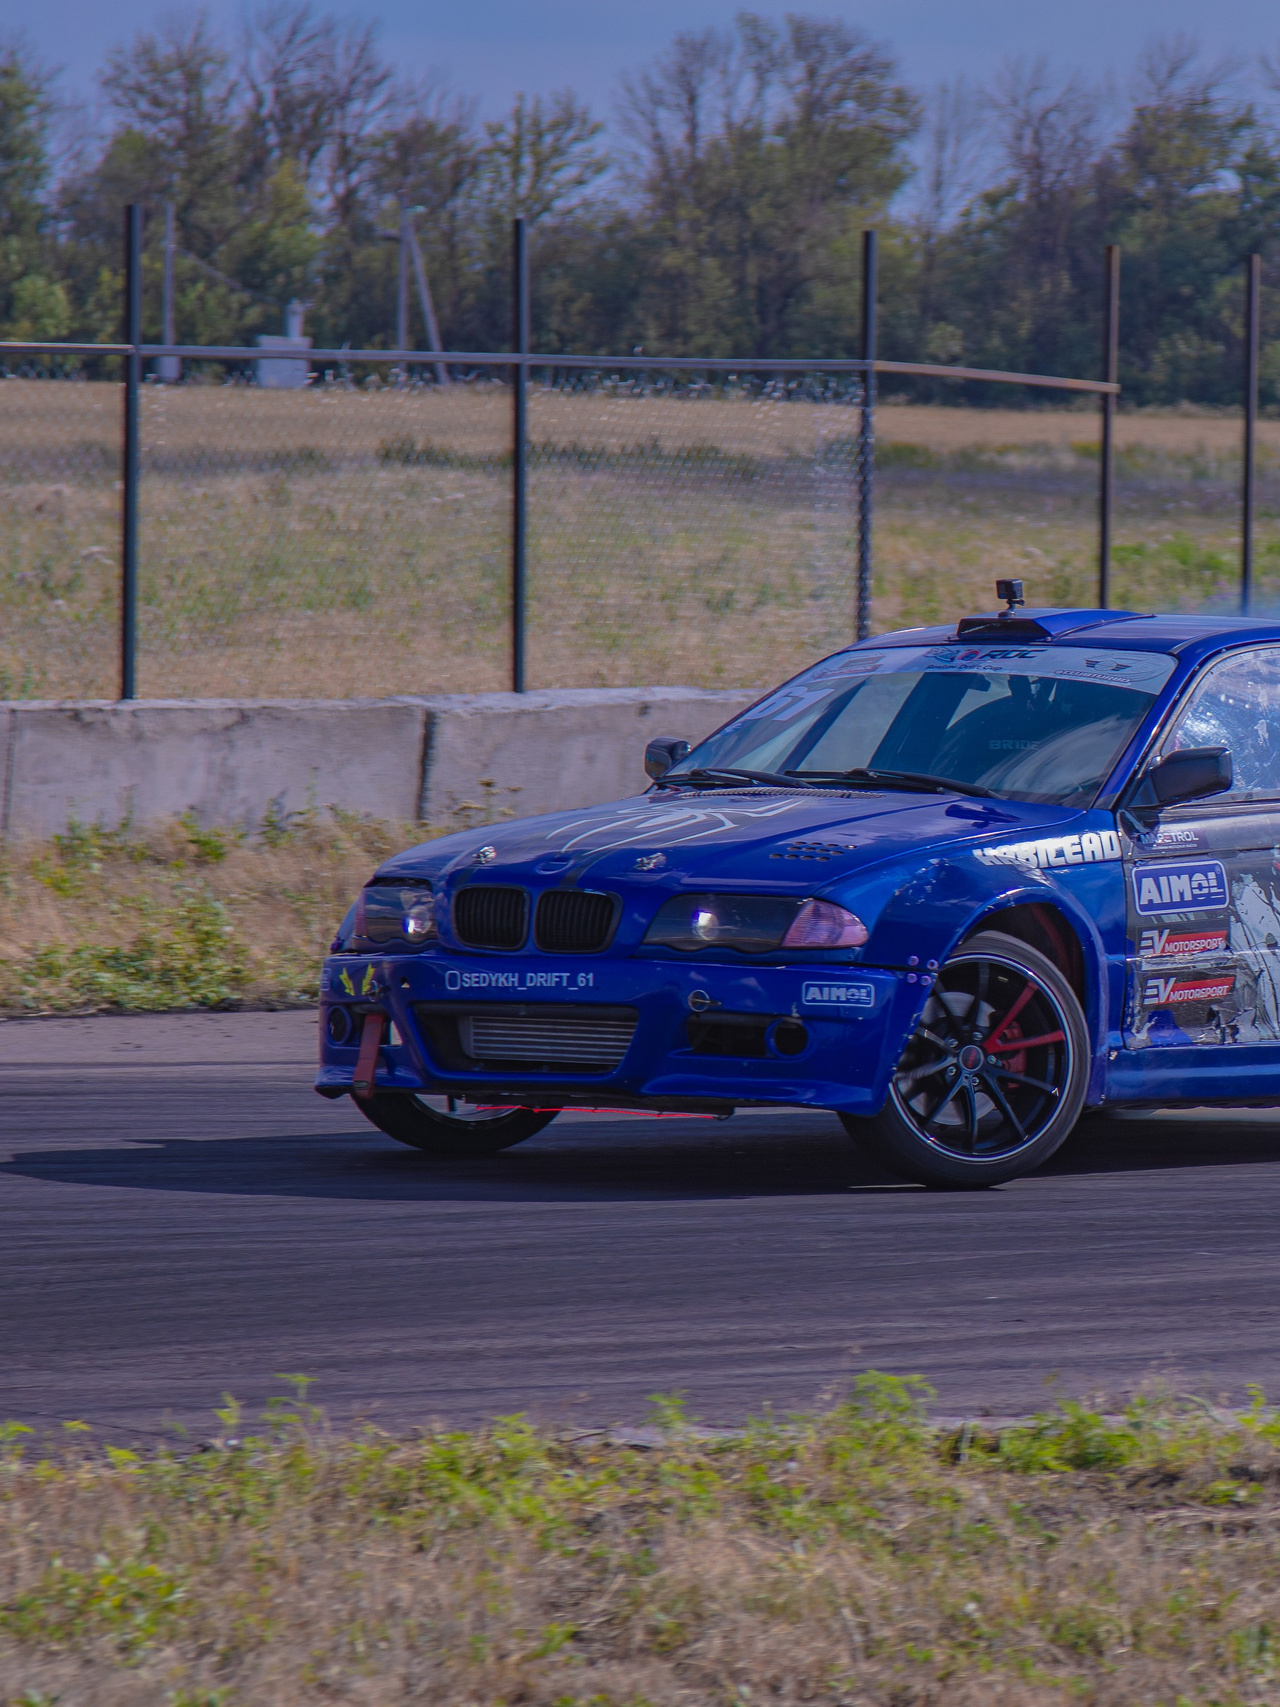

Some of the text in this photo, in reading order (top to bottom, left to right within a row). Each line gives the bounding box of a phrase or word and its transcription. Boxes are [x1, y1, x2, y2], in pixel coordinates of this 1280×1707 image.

[1139, 871, 1225, 905] AIMOL
[1164, 937, 1223, 953] MOTORSPORT
[805, 986, 871, 1003] AIMOL
[1169, 985, 1229, 1002] MOTORSPORT
